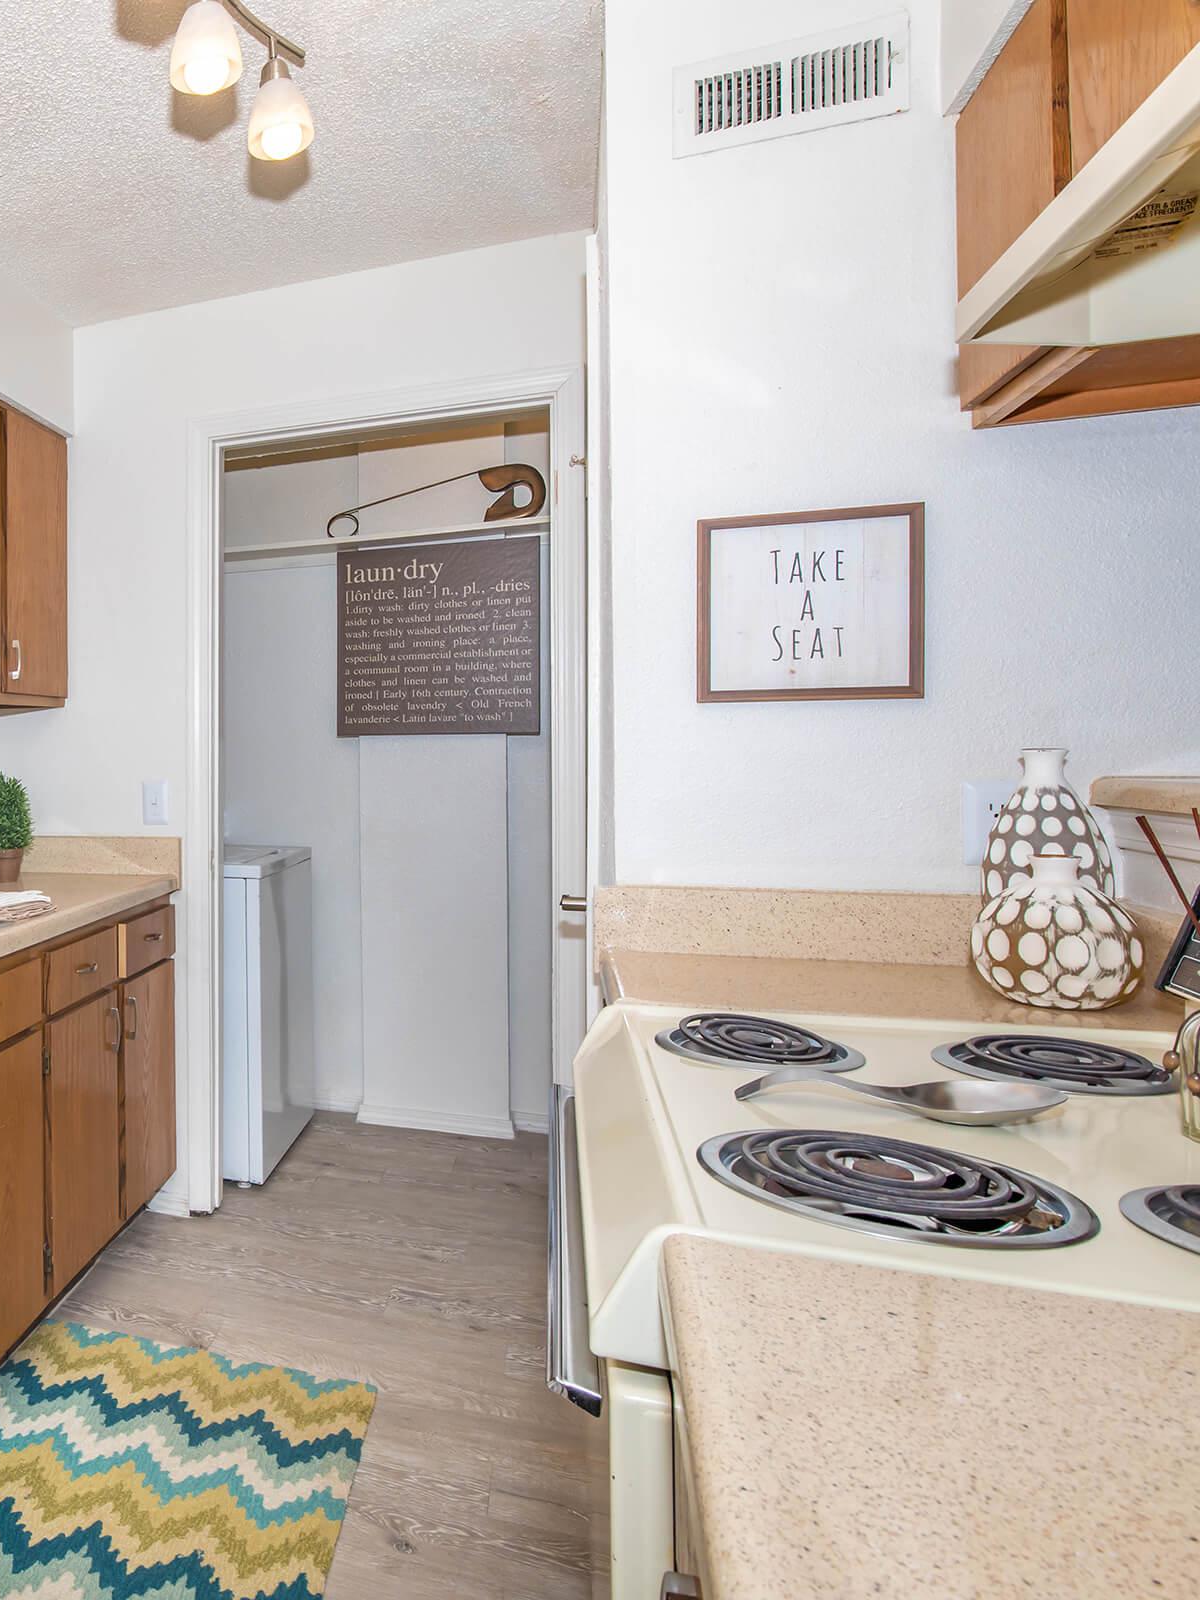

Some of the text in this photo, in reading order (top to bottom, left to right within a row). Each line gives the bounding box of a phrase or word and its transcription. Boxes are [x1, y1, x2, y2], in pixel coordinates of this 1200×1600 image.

[770, 550, 845, 584] TAKE
[490, 579, 530, 593] -dries
[408, 602, 429, 612] dirty
[434, 600, 468, 610] clothes
[487, 597, 511, 606] linen
[516, 596, 531, 606] put
[800, 590, 815, 621] A
[345, 618, 368, 626] aside
[370, 618, 380, 626] to
[383, 616, 394, 624] be
[397, 614, 431, 624] washed
[434, 612, 452, 621] and
[506, 608, 532, 618] clean
[373, 628, 404, 639] freshly
[406, 626, 440, 636] washed
[442, 624, 476, 634] clothes
[492, 622, 516, 631] linen
[345, 642, 382, 652] washing
[388, 641, 405, 649] and
[412, 638, 446, 648] ironing
[772, 625, 844, 661] SEAT
[345, 653, 388, 664] especially
[398, 650, 452, 661] commercial
[454, 648, 519, 658] establishment
[521, 648, 533, 656] or
[354, 665, 400, 675] communal
[432, 664, 442, 672] in
[502, 660, 532, 669] where
[345, 679, 376, 688] clothes
[382, 678, 398, 686] and
[404, 677, 426, 686] linen
[454, 675, 466, 684] be
[472, 672, 508, 683] washed
[514, 672, 532, 682] and
[384, 689, 407, 700] Early
[412, 689, 431, 698] 16th
[474, 686, 532, 696] Contraction
[345, 704, 355, 712] of
[362, 702, 399, 712] obsolete
[408, 701, 448, 712] lavendry
[471, 700, 489, 709] Old
[498, 698, 532, 708] French
[345, 715, 390, 724] lavanderie
[402, 714, 426, 722] Latin
[428, 713, 456, 722] lavare
